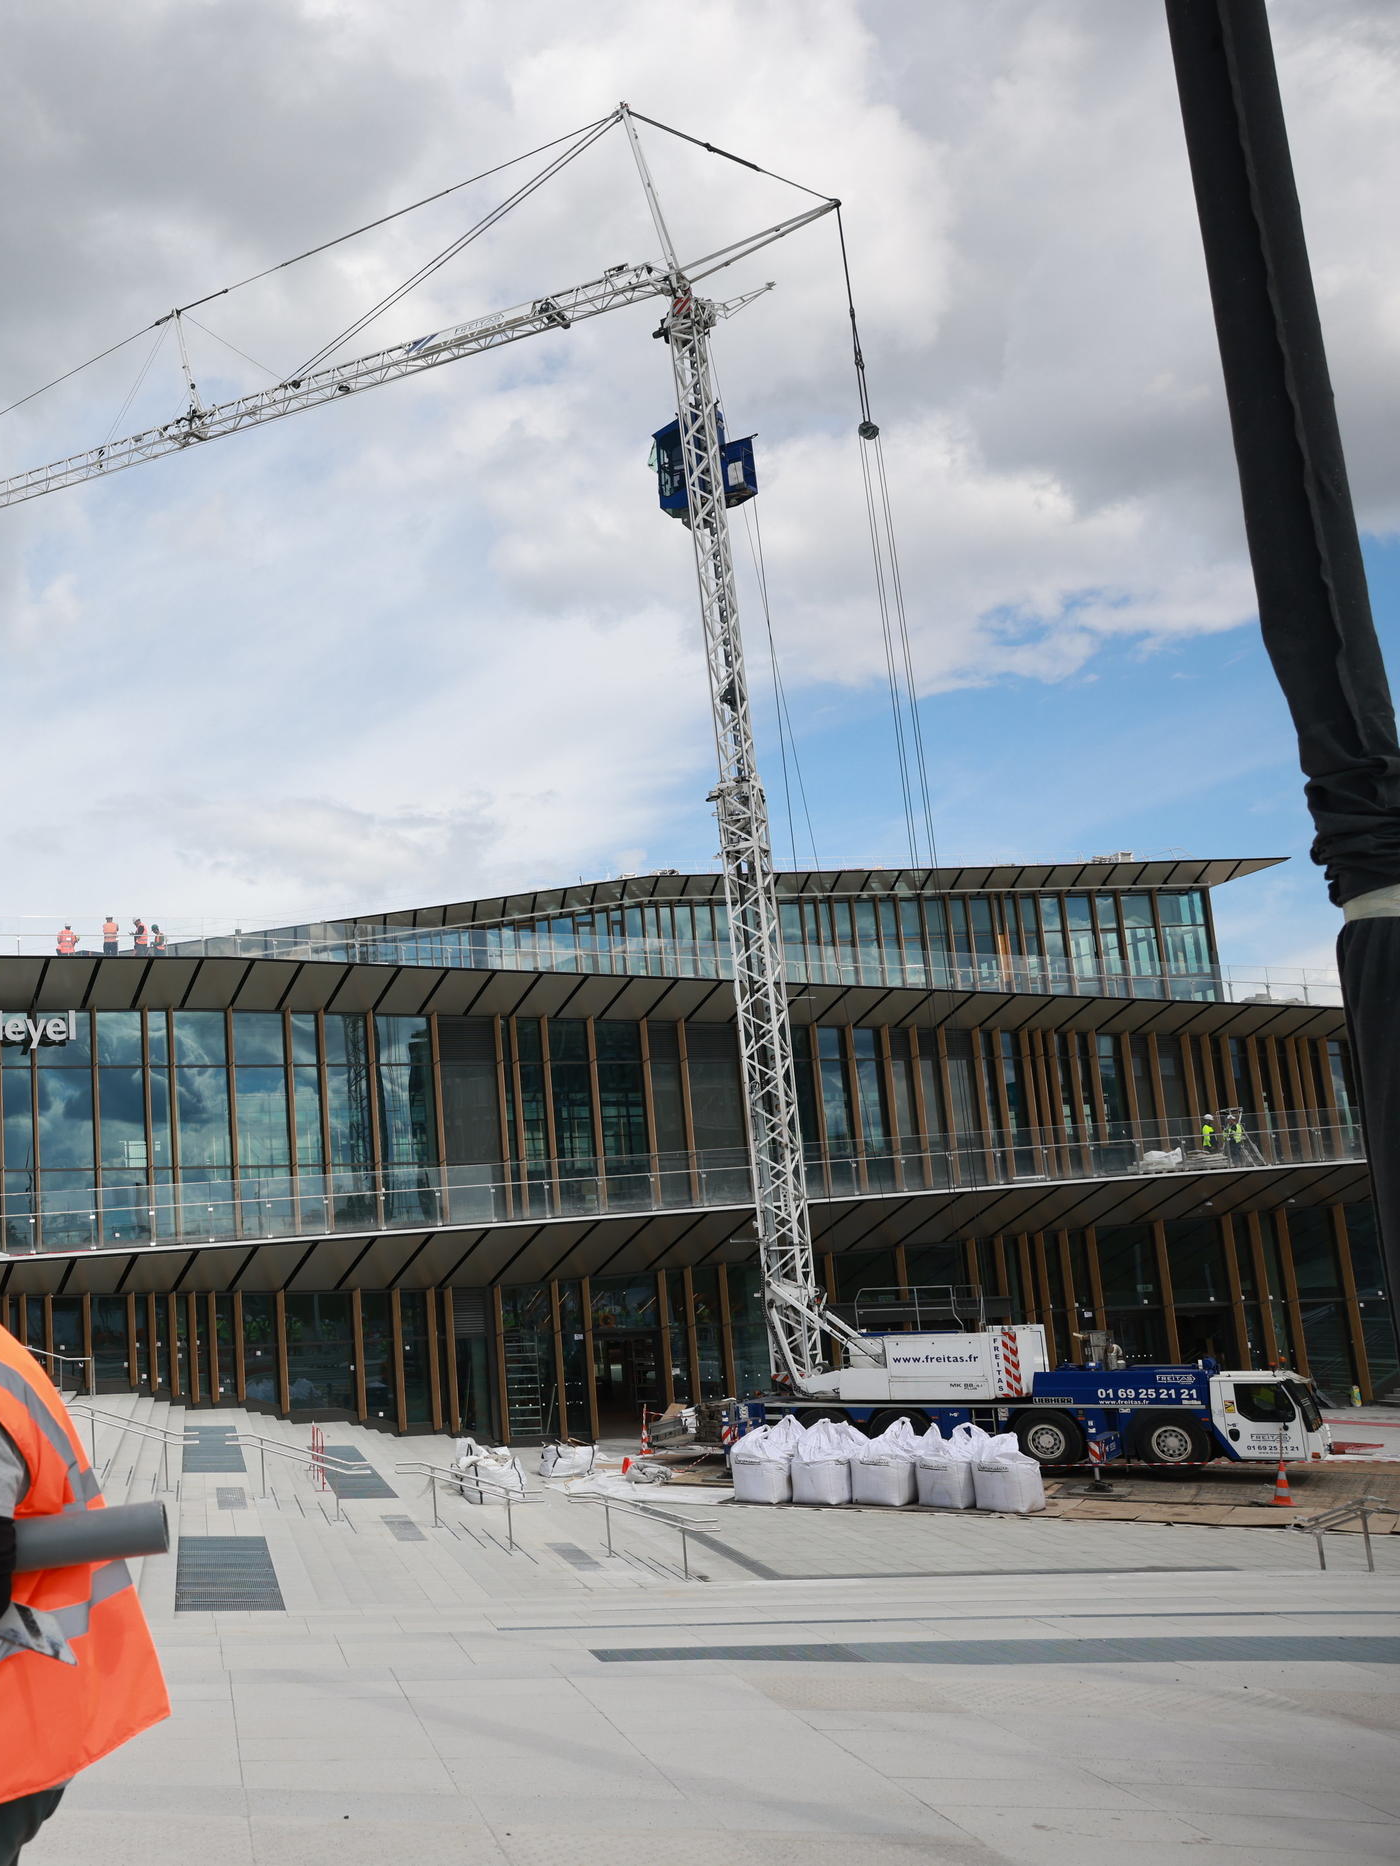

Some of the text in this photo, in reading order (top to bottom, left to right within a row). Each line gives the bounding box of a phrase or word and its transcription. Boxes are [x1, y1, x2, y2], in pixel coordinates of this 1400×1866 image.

[892, 1354, 979, 1363] www.freitas.fr
[993, 1338, 1004, 1392] FREITAS
[1156, 1375, 1195, 1383] FREITAS
[1097, 1389, 1197, 1398] 01 69 25 21 21
